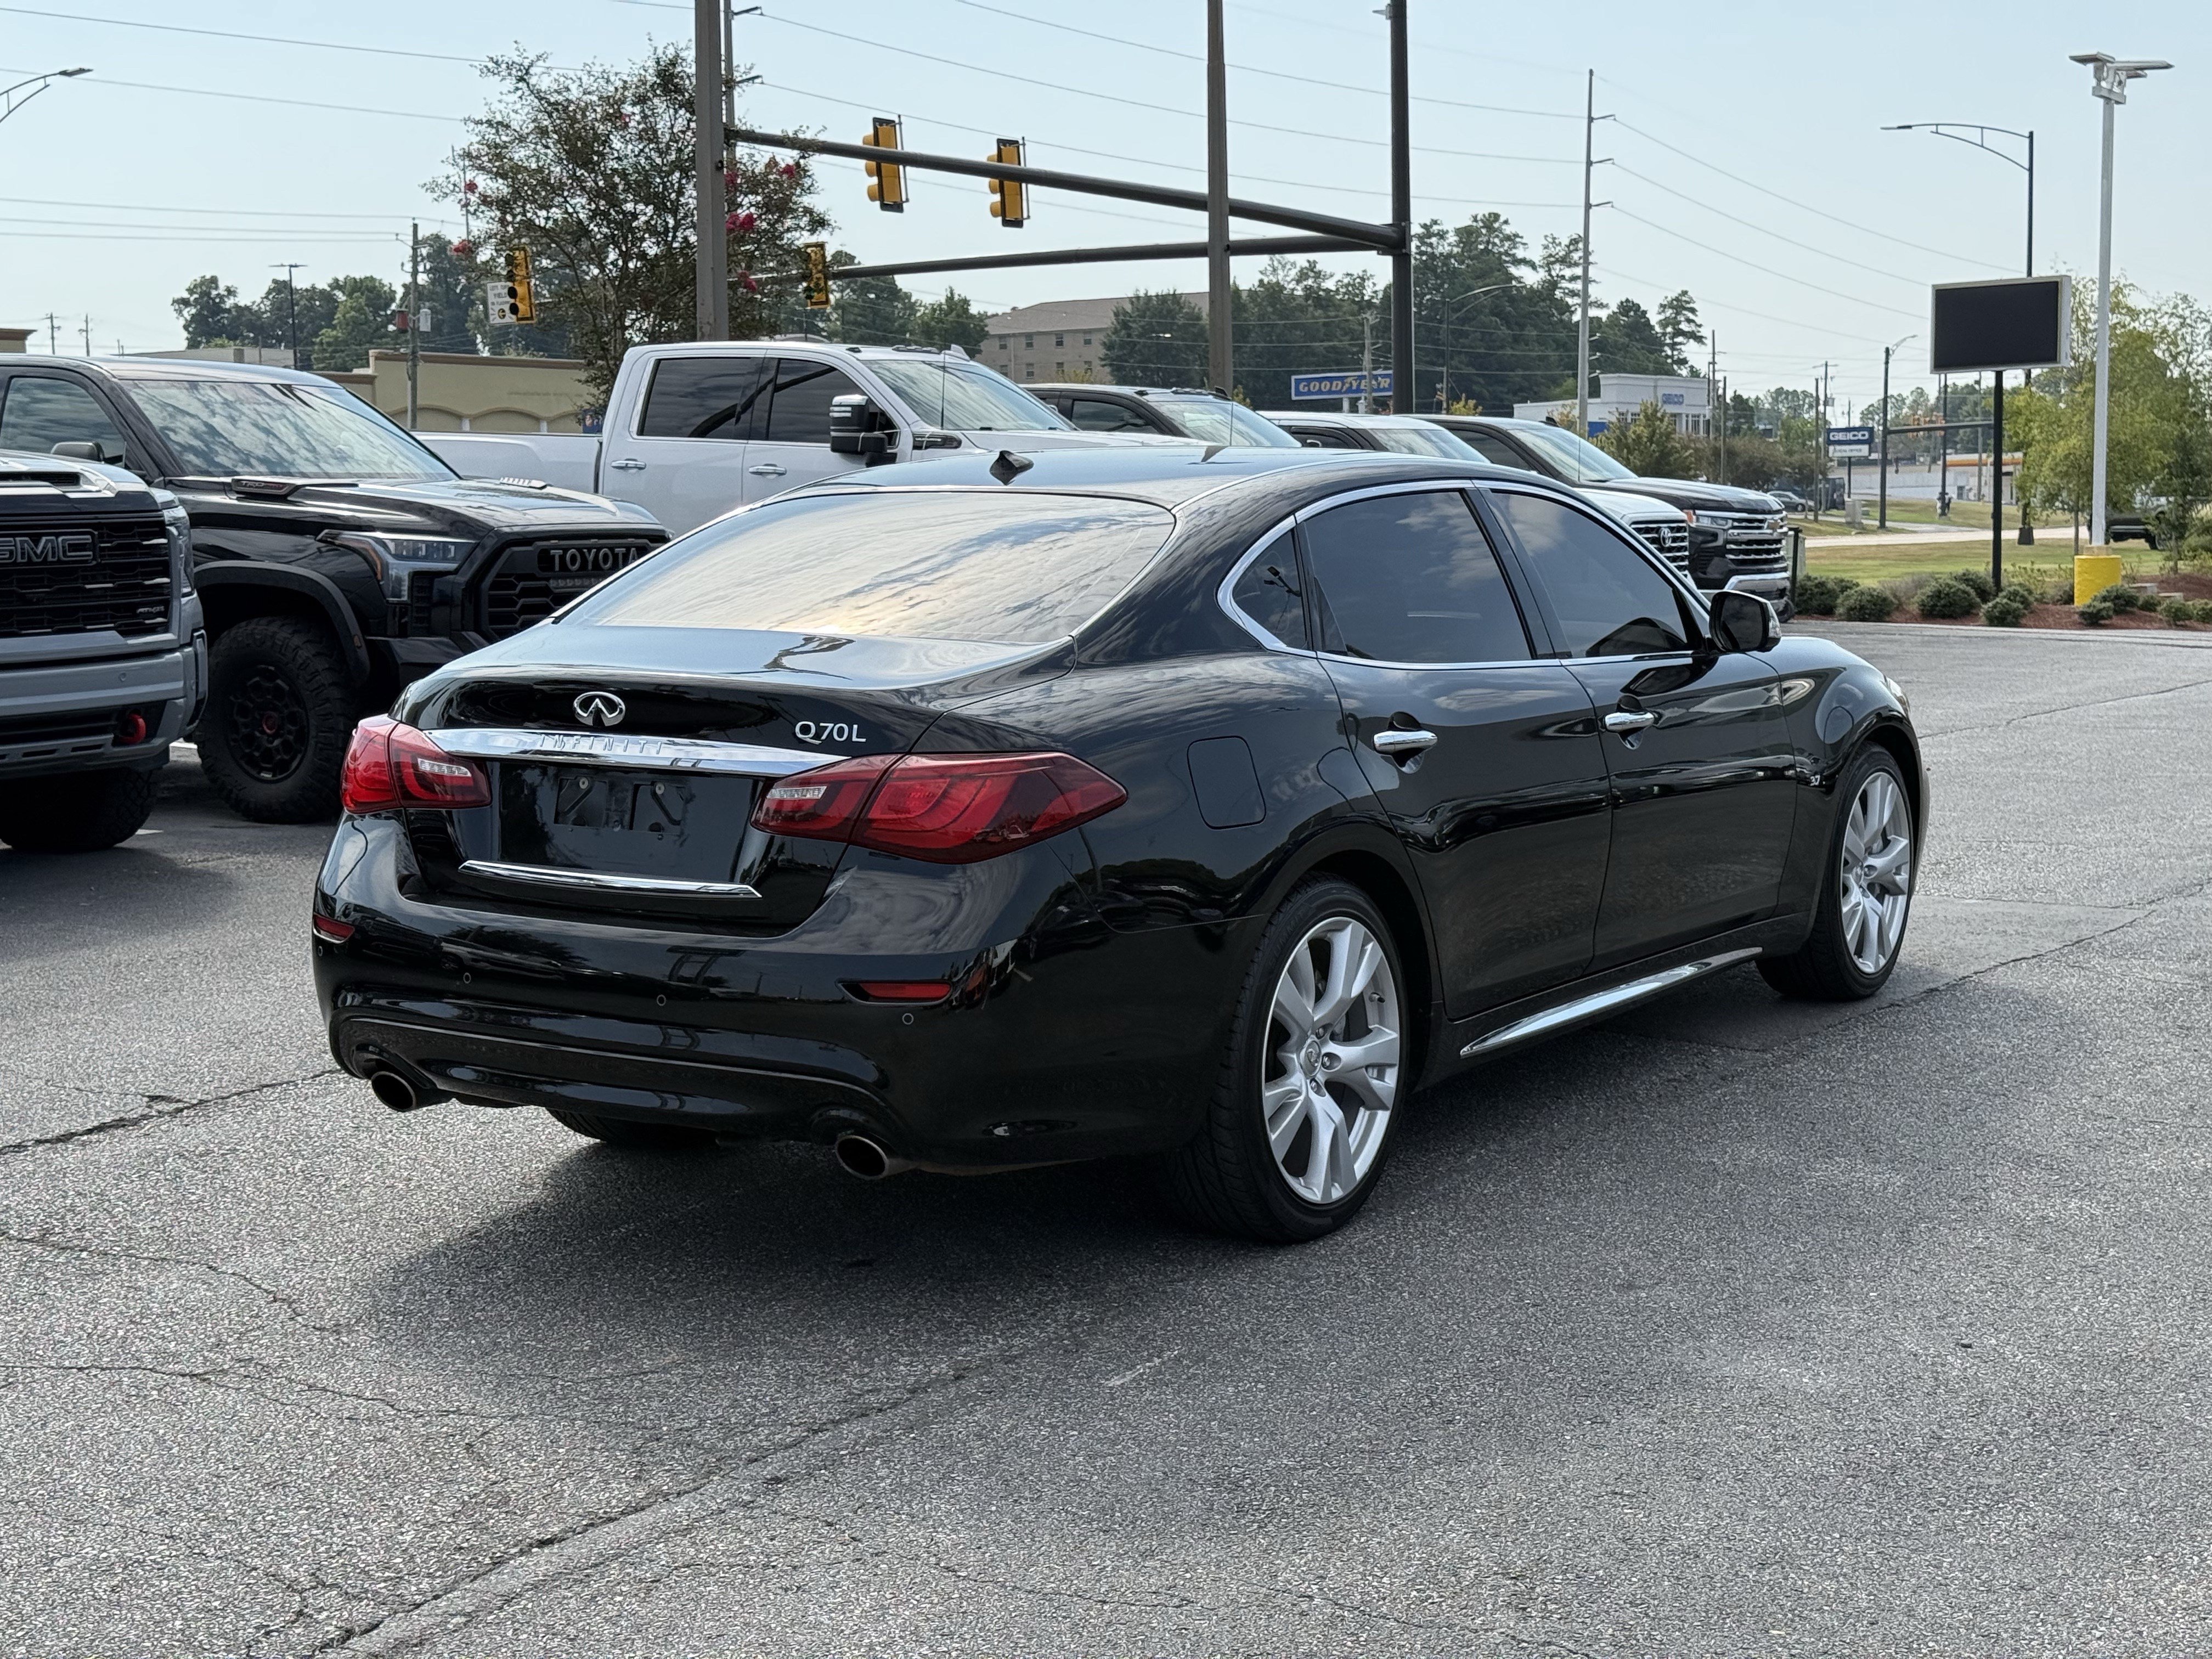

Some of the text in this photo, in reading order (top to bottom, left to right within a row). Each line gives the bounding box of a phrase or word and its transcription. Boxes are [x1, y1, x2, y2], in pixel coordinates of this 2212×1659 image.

[1299, 377, 1390, 392] GOODYEAR
[1830, 431, 1869, 441] GEICO
[550, 548, 638, 572] TOYOTA
[795, 721, 867, 745] Q70L
[540, 734, 662, 755] INFINITI
